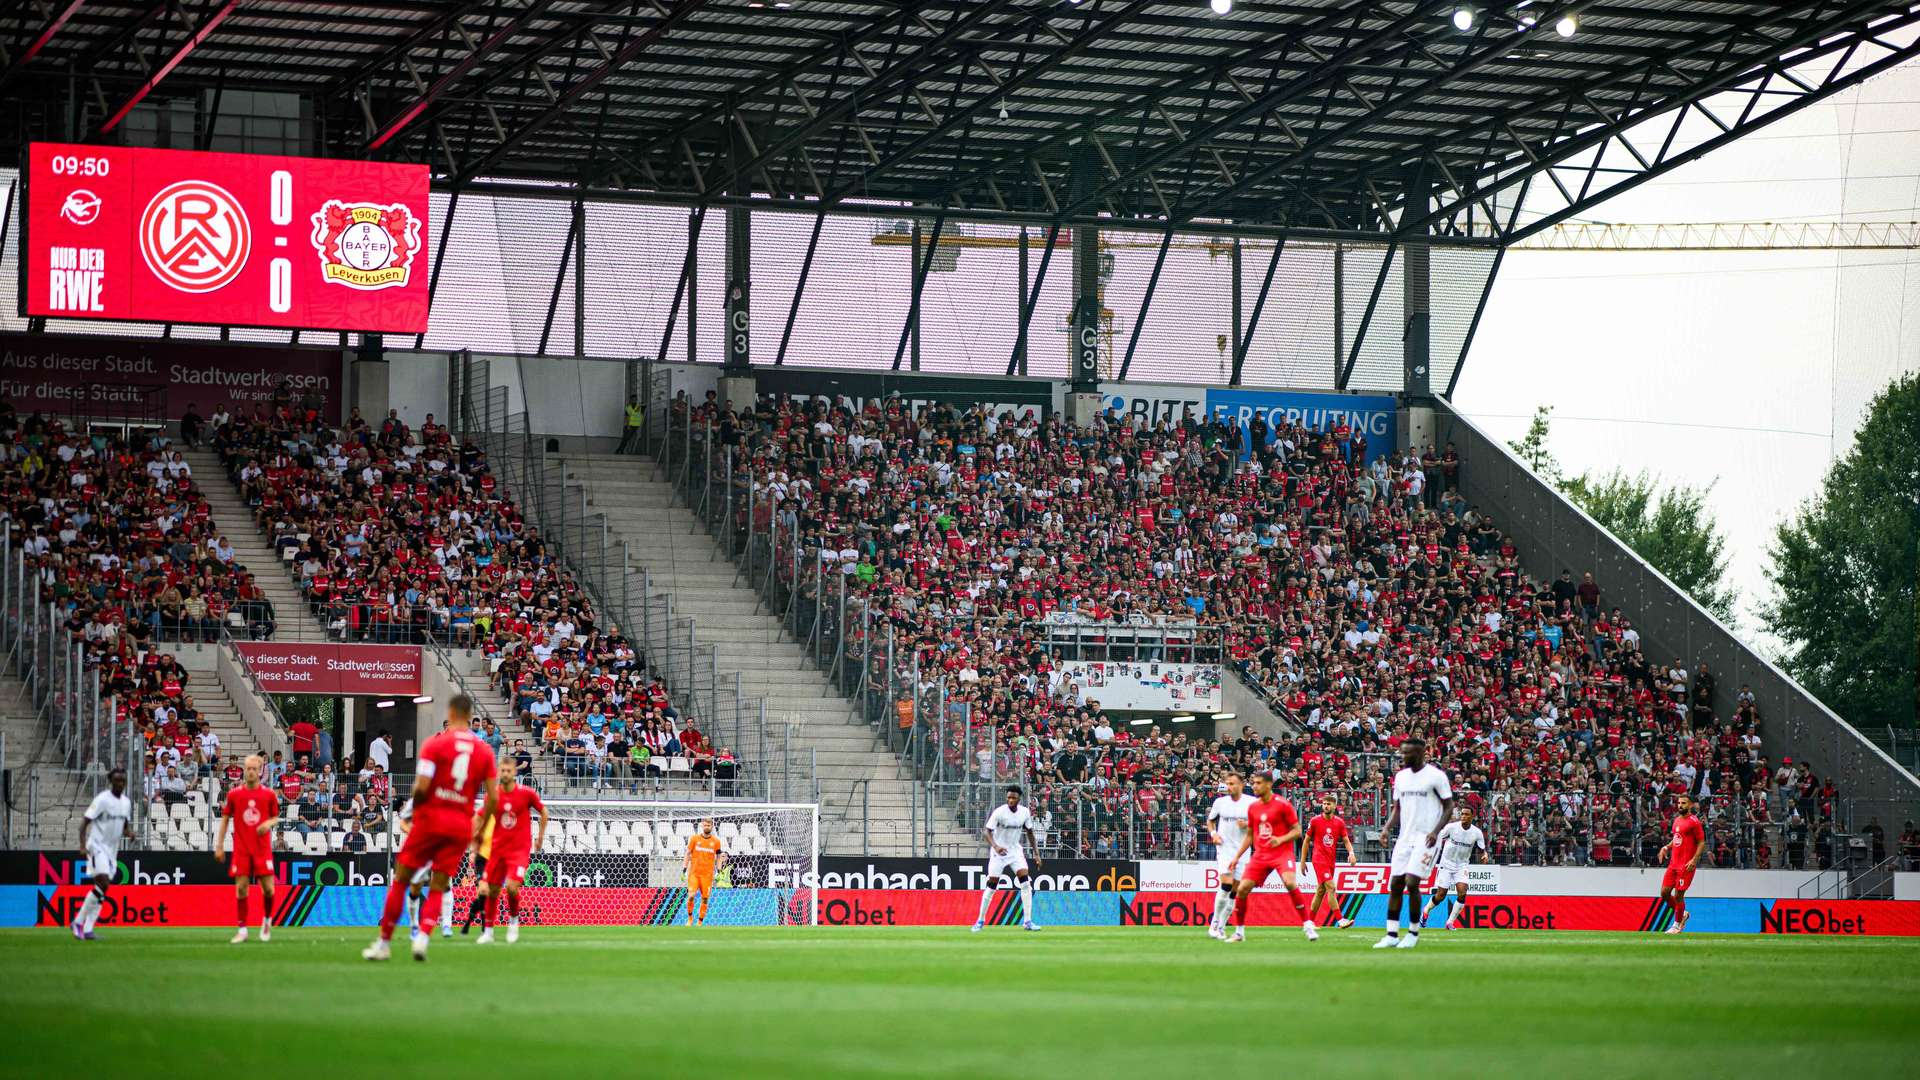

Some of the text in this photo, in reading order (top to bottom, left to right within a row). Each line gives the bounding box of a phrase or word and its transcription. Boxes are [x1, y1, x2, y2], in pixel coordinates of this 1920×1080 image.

[52, 156, 110, 177] 09:50
[271, 170, 292, 225] 0
[354, 210, 378, 220] 1904
[345, 241, 387, 251] BAYER
[50, 247, 105, 270] NUR DER
[332, 266, 399, 283] Leverkusen
[49, 270, 105, 311] RWE
[269, 257, 292, 313] 0
[2, 351, 157, 374] Aus dieser Stadt.
[0, 380, 30, 398] Für
[35, 381, 86, 399] diese
[229, 389, 249, 401] Wir
[257, 654, 289, 666] dieser
[290, 655, 320, 666] Stadt.
[284, 670, 313, 682] Stadt.
[359, 672, 416, 681] Wir sind Zuhause.
[1141, 881, 1192, 889] Pufferspeicher
